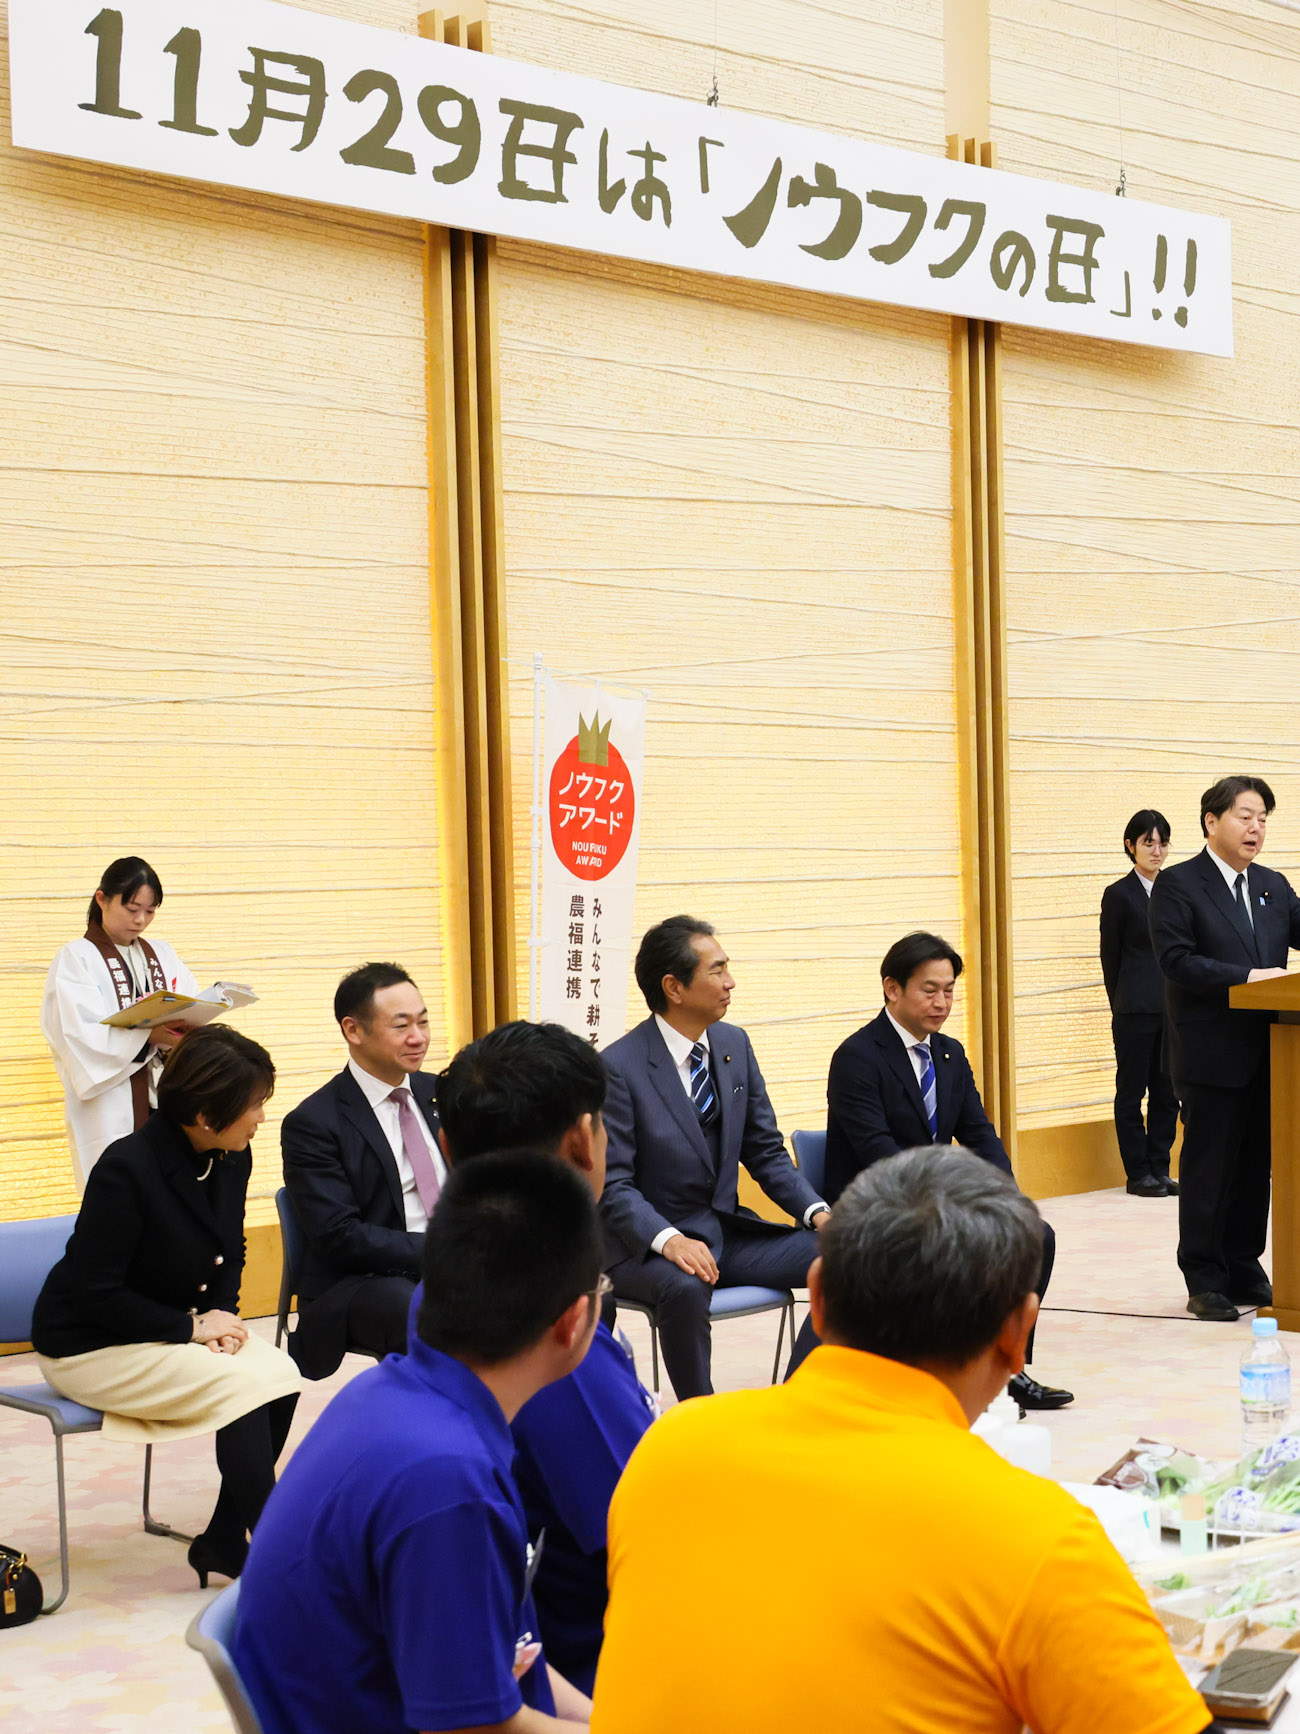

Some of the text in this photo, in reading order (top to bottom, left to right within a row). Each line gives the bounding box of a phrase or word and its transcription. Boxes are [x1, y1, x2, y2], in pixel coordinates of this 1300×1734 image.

[559, 771, 625, 804] ノウフク
[558, 803, 623, 835] アワード
[566, 894, 585, 999] 農福連携
[150, 958, 164, 989] みんな
